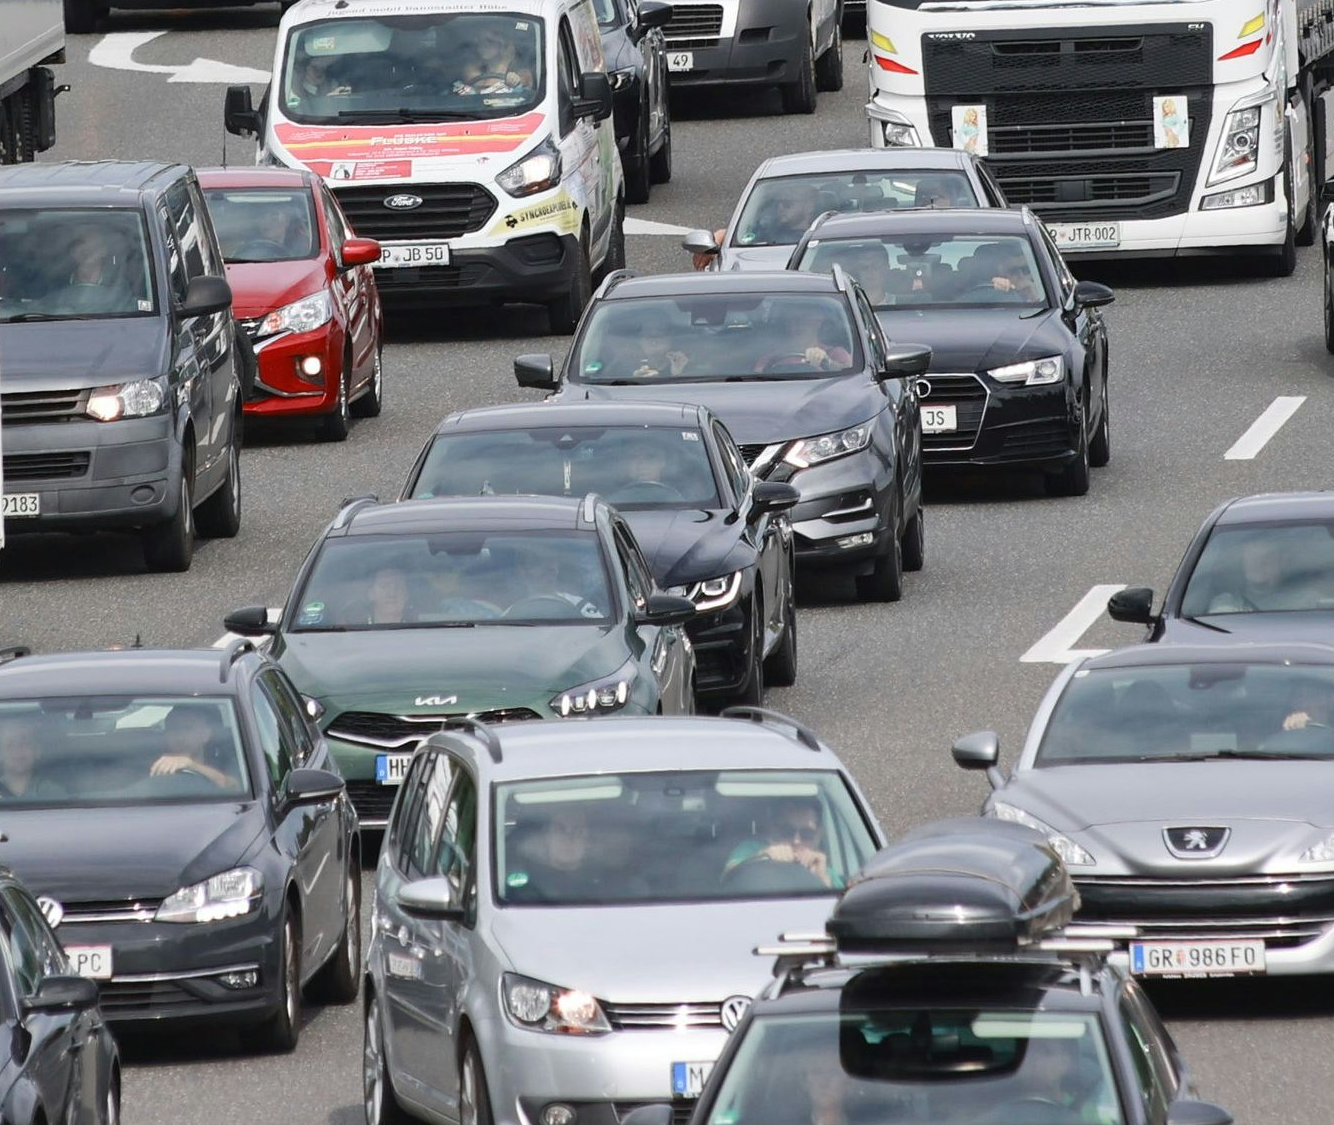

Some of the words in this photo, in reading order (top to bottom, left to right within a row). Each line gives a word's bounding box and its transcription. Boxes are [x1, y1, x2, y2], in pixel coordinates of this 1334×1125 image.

[673, 55, 688, 66] 49
[403, 248, 422, 262] JB
[426, 247, 443, 260] 50
[926, 411, 945, 426] JS
[1149, 949, 1173, 968] GR
